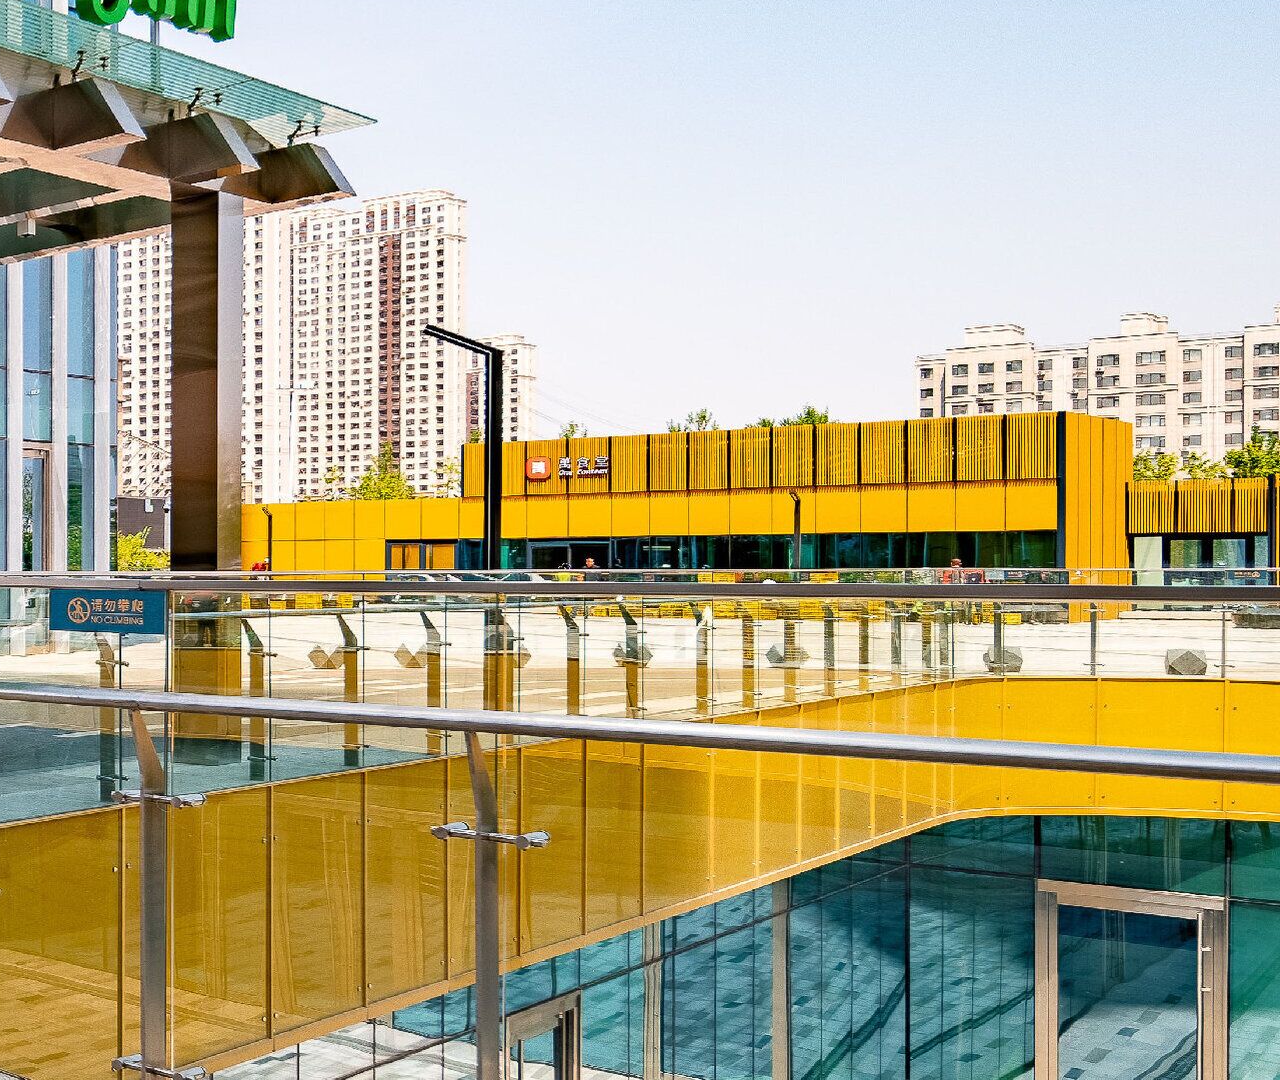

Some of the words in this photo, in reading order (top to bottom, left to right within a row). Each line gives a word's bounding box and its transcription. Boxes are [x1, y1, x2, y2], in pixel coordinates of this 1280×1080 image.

[91, 599, 144, 612] 请勿攀爬
[91, 616, 103, 624] NO
[104, 616, 144, 625] CLIMBING
